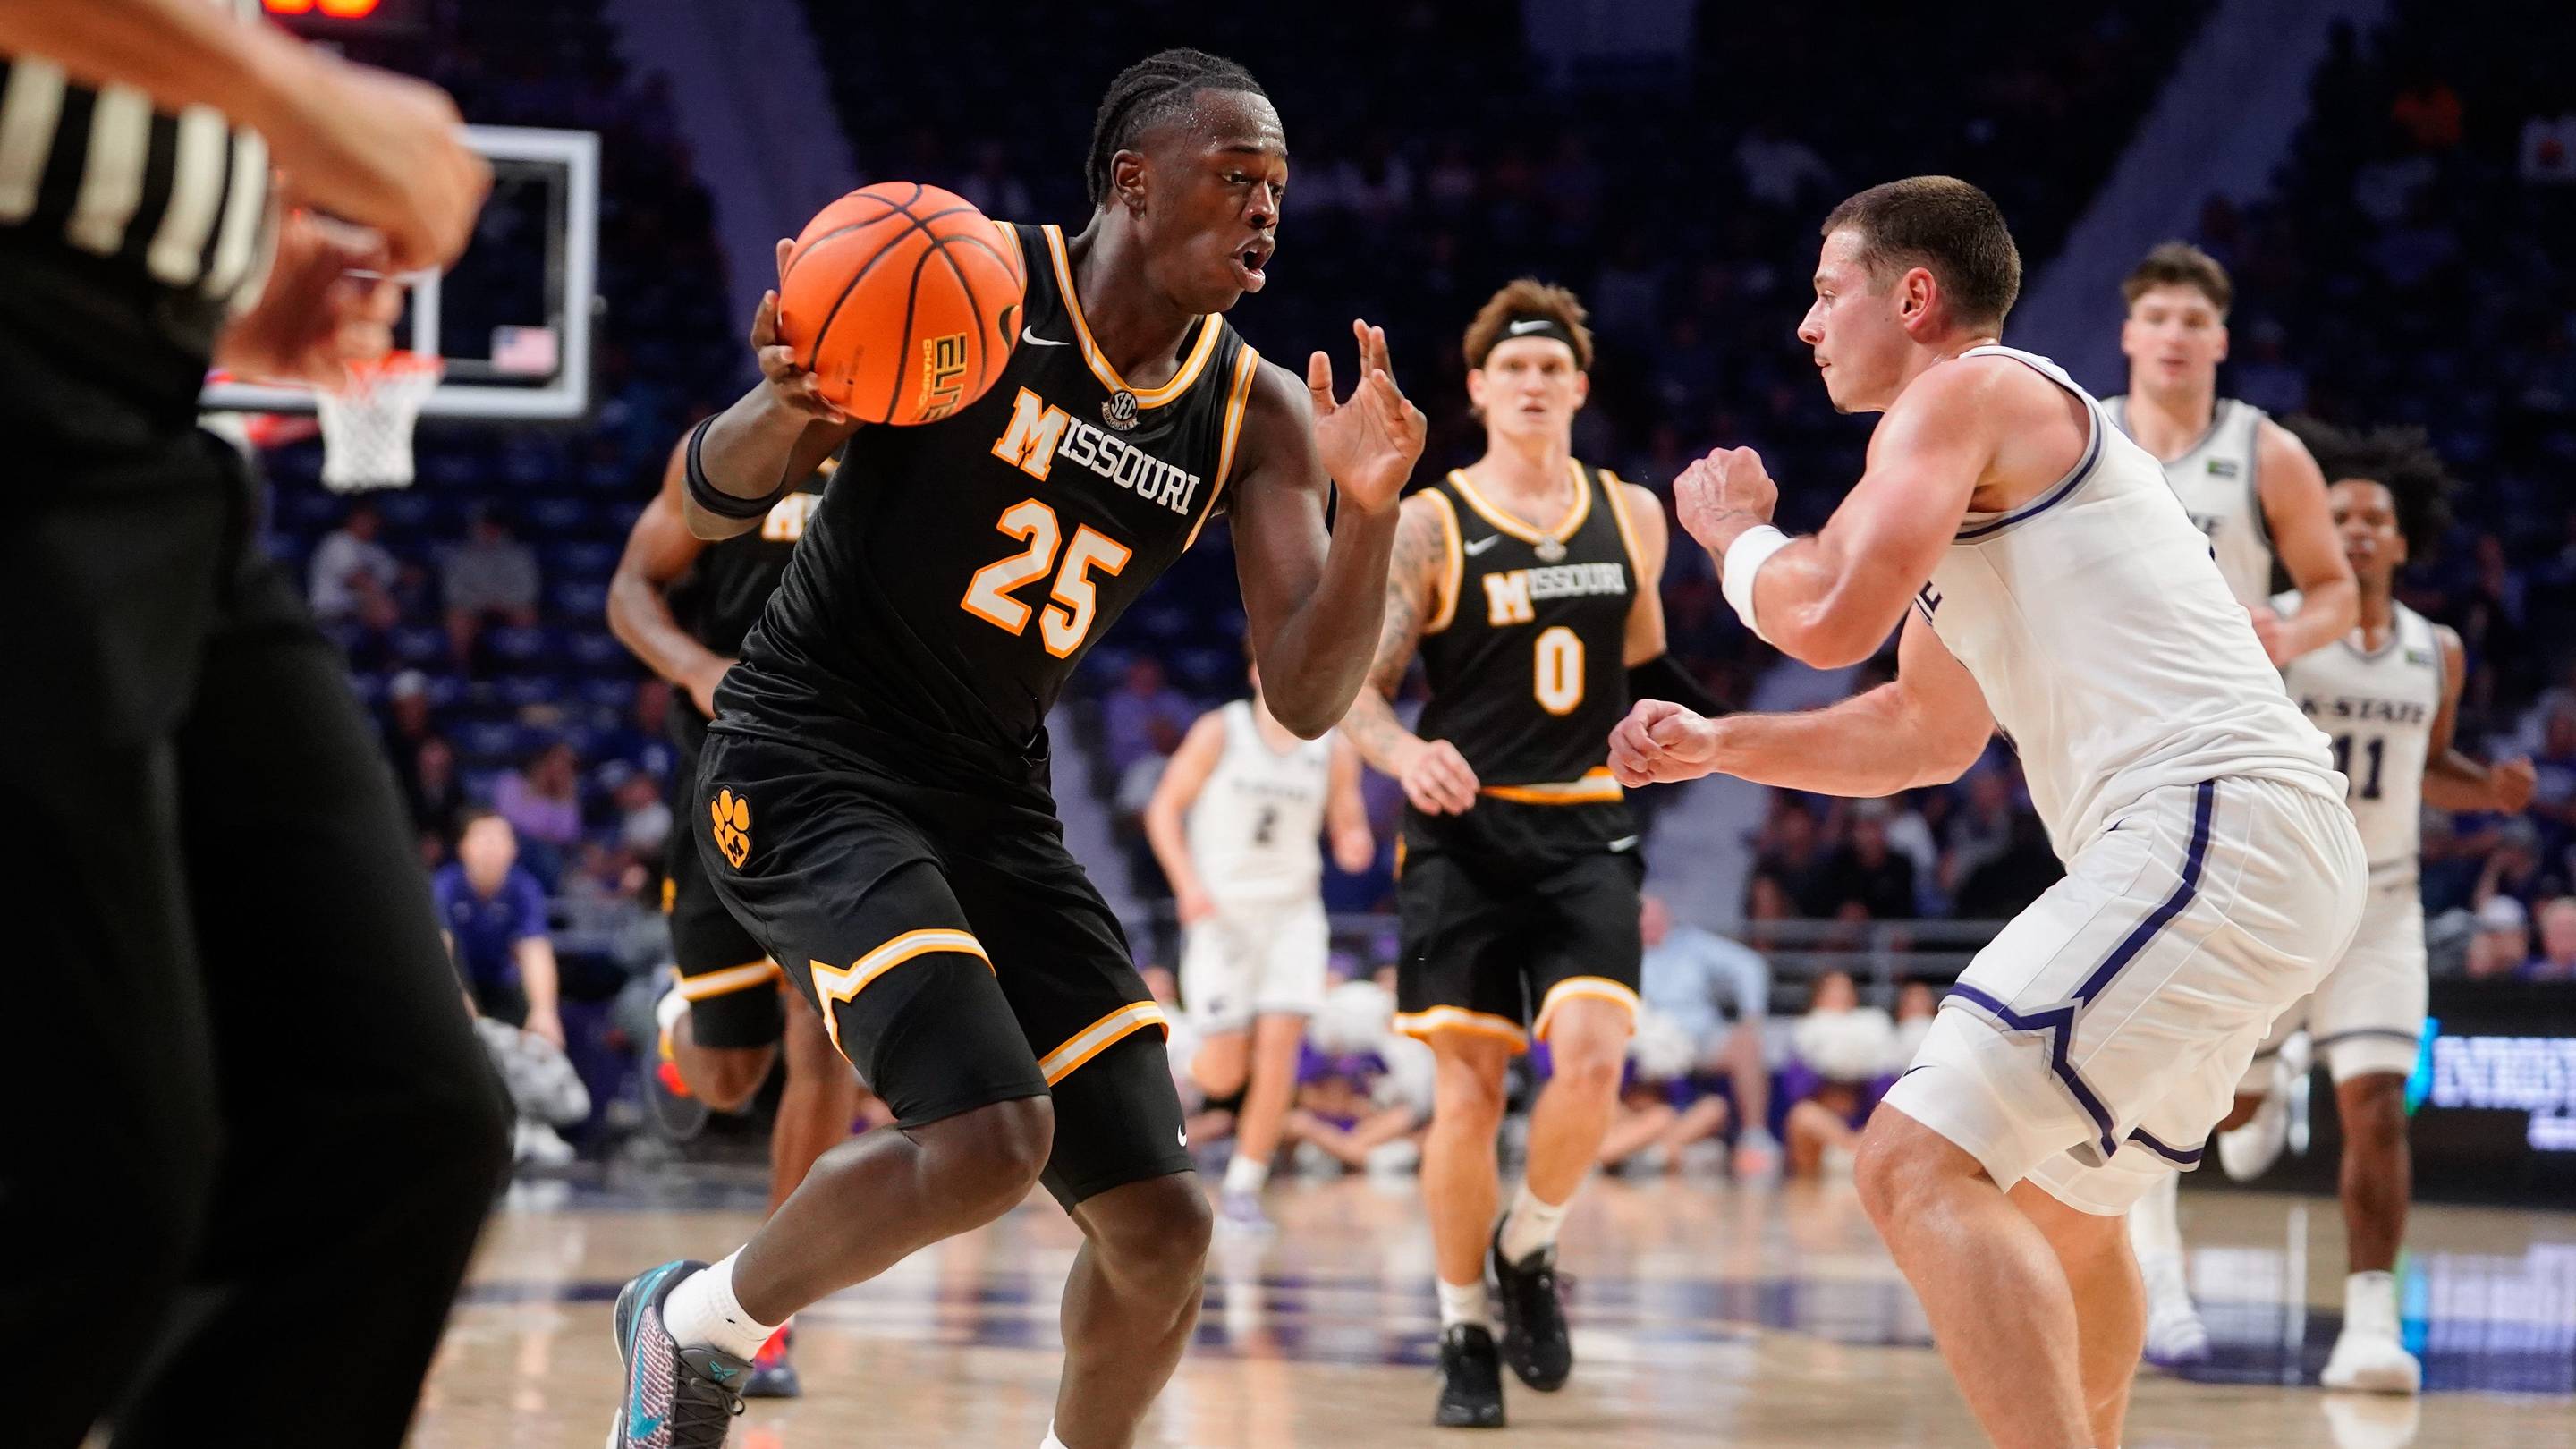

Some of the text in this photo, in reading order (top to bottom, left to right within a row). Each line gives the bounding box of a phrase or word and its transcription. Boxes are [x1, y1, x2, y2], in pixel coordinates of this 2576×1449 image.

[919, 332, 967, 421] ELITE
[1111, 392, 1137, 420] SEC
[991, 386, 1200, 516] MISSOURI
[961, 497, 1132, 659] 25
[1482, 563, 1627, 628] MISSOURI
[1534, 626, 1585, 716] 0
[2334, 733, 2384, 800] 11
[727, 835, 744, 863] M
